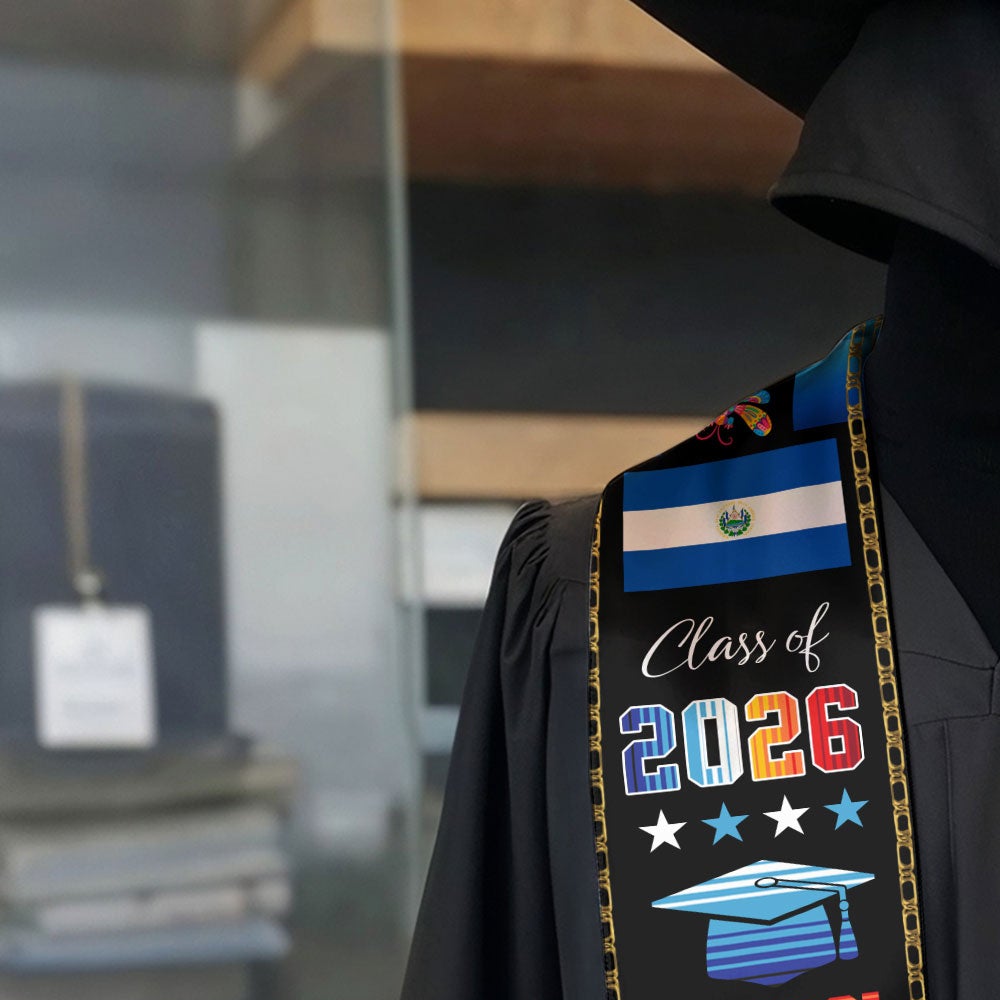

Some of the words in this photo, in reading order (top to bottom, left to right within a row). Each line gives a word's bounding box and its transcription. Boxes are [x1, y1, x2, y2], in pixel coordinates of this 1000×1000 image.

[641, 616, 776, 678] Class
[785, 602, 830, 673] of
[619, 683, 865, 796] 2026
